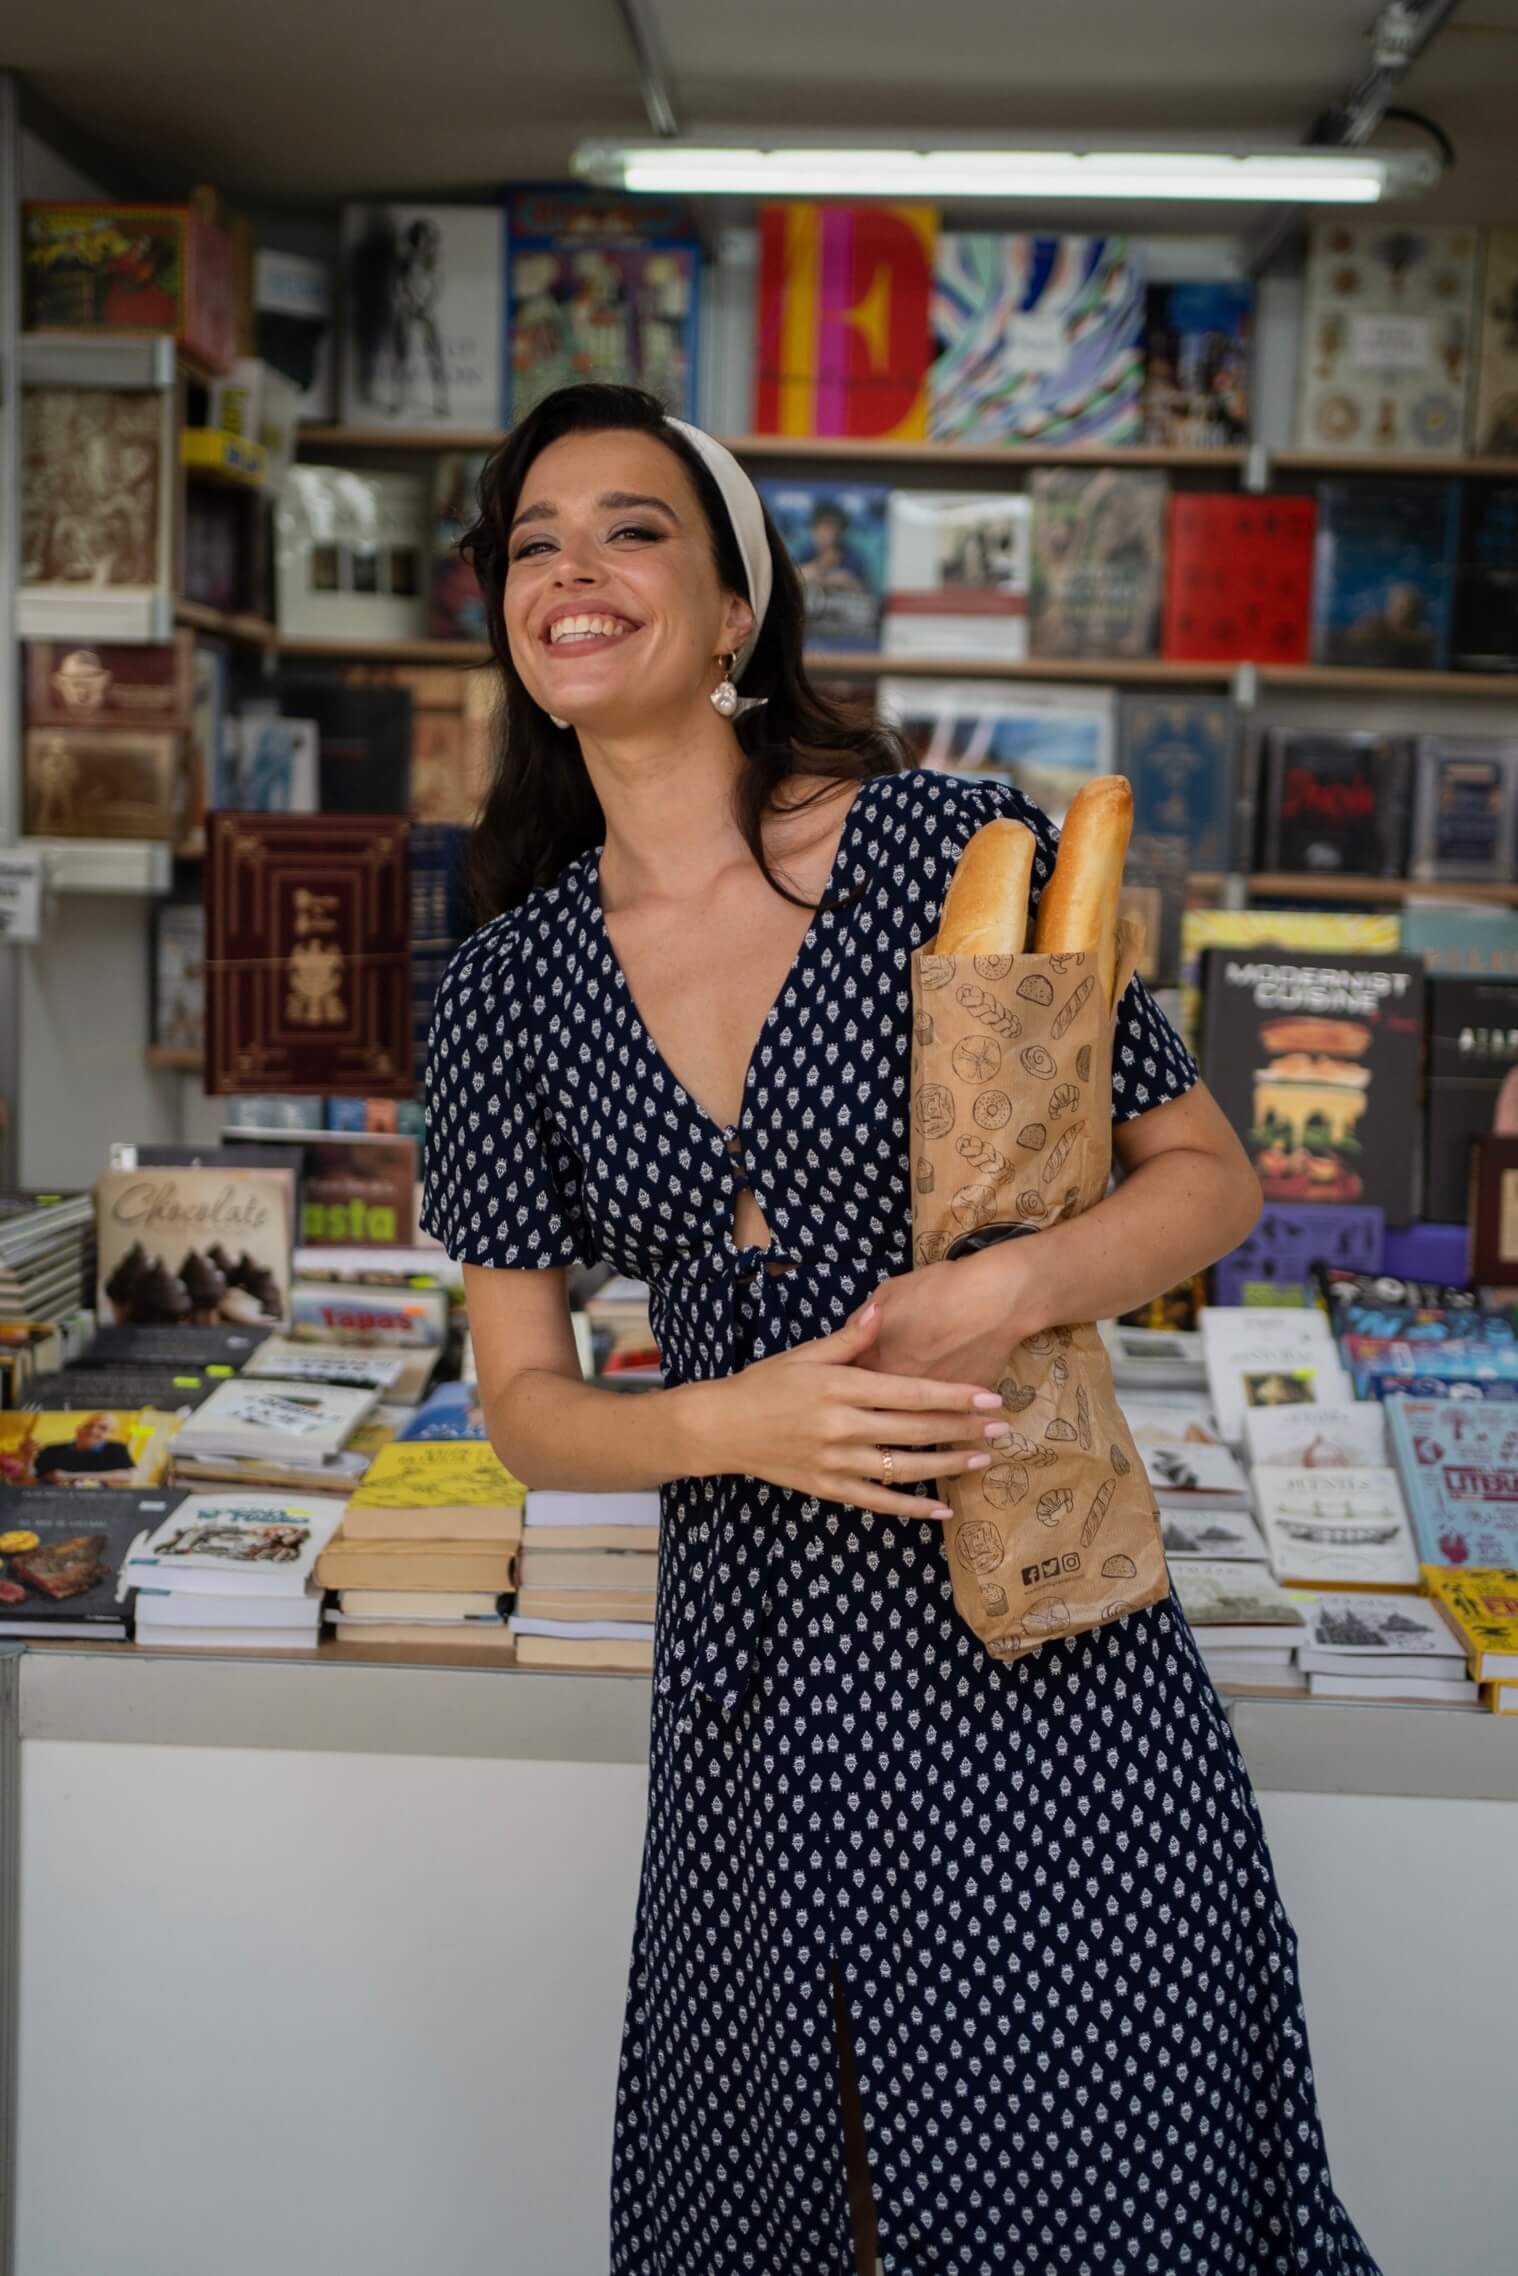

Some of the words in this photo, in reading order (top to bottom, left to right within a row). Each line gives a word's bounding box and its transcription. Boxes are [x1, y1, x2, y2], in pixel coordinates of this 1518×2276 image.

[1225, 961, 1411, 998] MODERNIST
[1254, 982, 1378, 1016] CUISINE
[111, 1181, 268, 1229] Chocolate
[303, 1195, 395, 1241] asta
